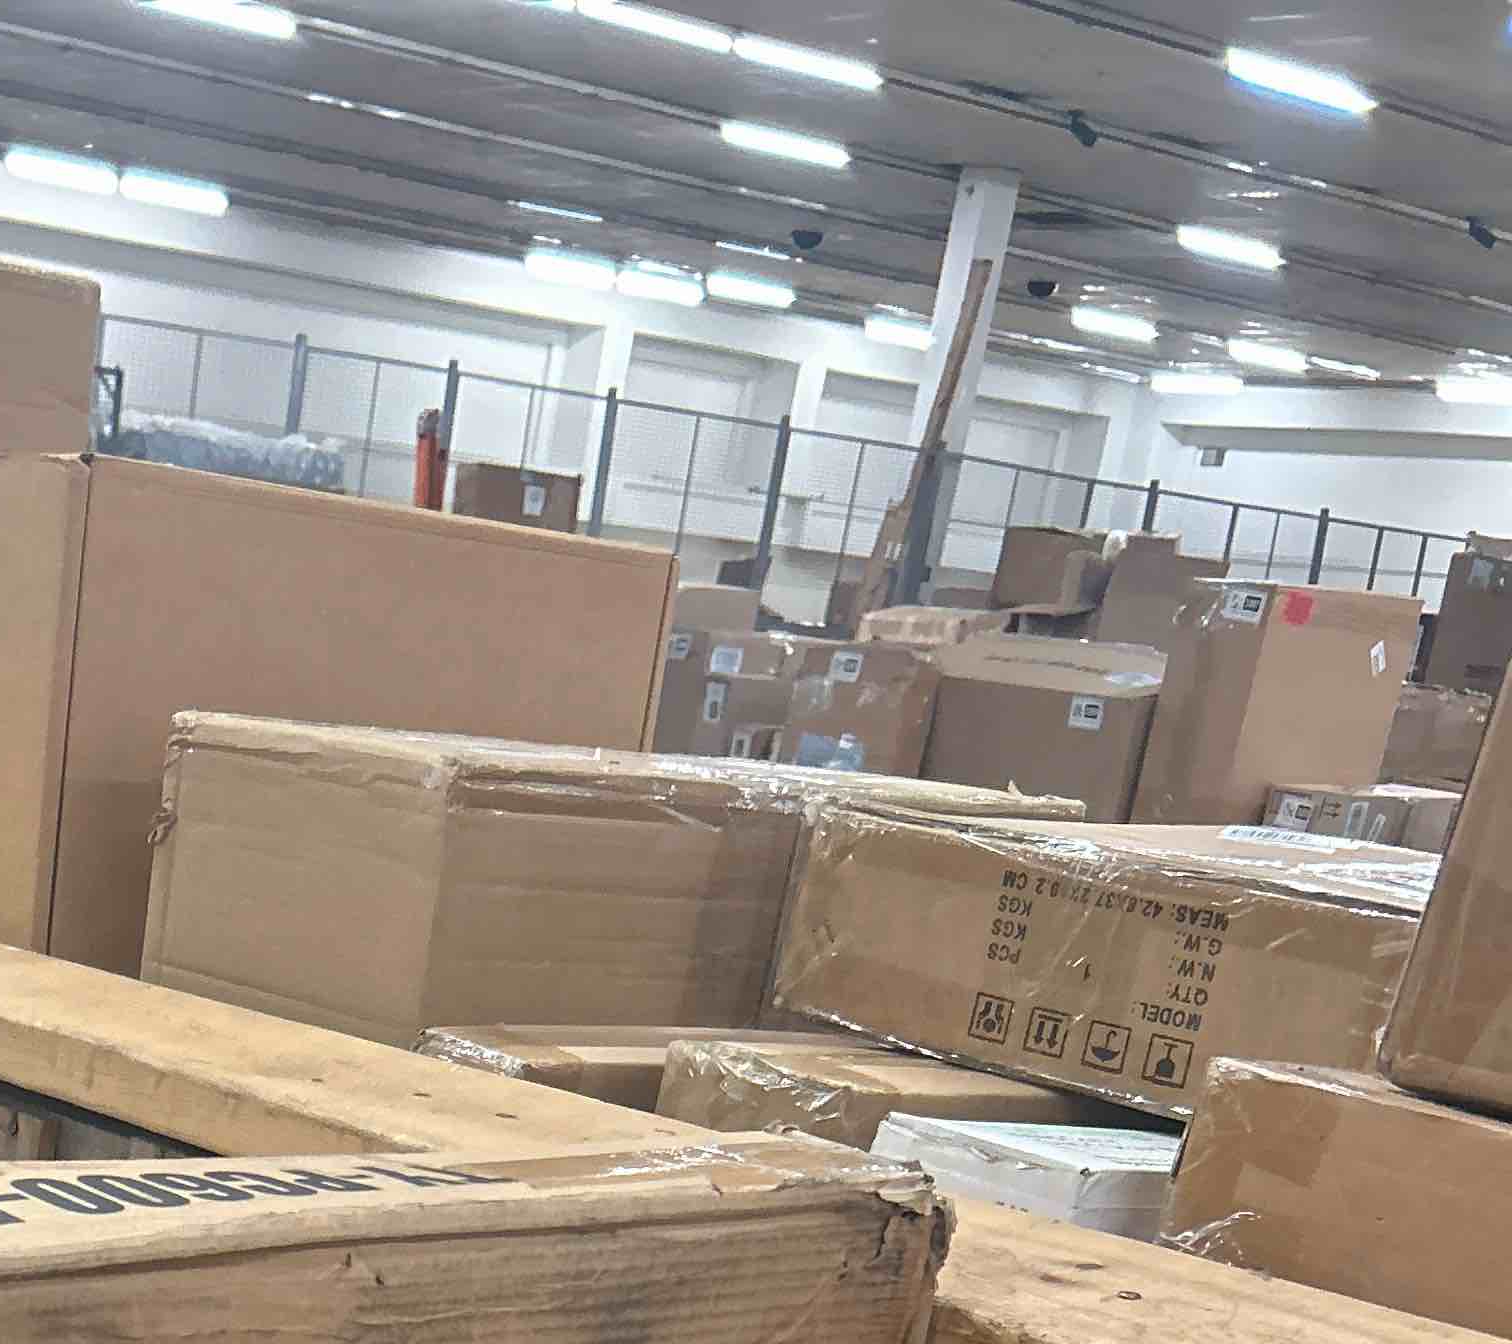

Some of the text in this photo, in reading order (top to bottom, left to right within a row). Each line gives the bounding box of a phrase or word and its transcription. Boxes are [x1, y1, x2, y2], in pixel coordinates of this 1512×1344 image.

[1001, 870, 1028, 890] CM
[997, 896, 1032, 916] KGS
[1172, 903, 1230, 931] MEAS:
[991, 918, 1027, 940] KGS
[988, 943, 1021, 964] PCS
[1166, 982, 1208, 1006] QTY:
[1130, 1001, 1203, 1031] MODEL:
